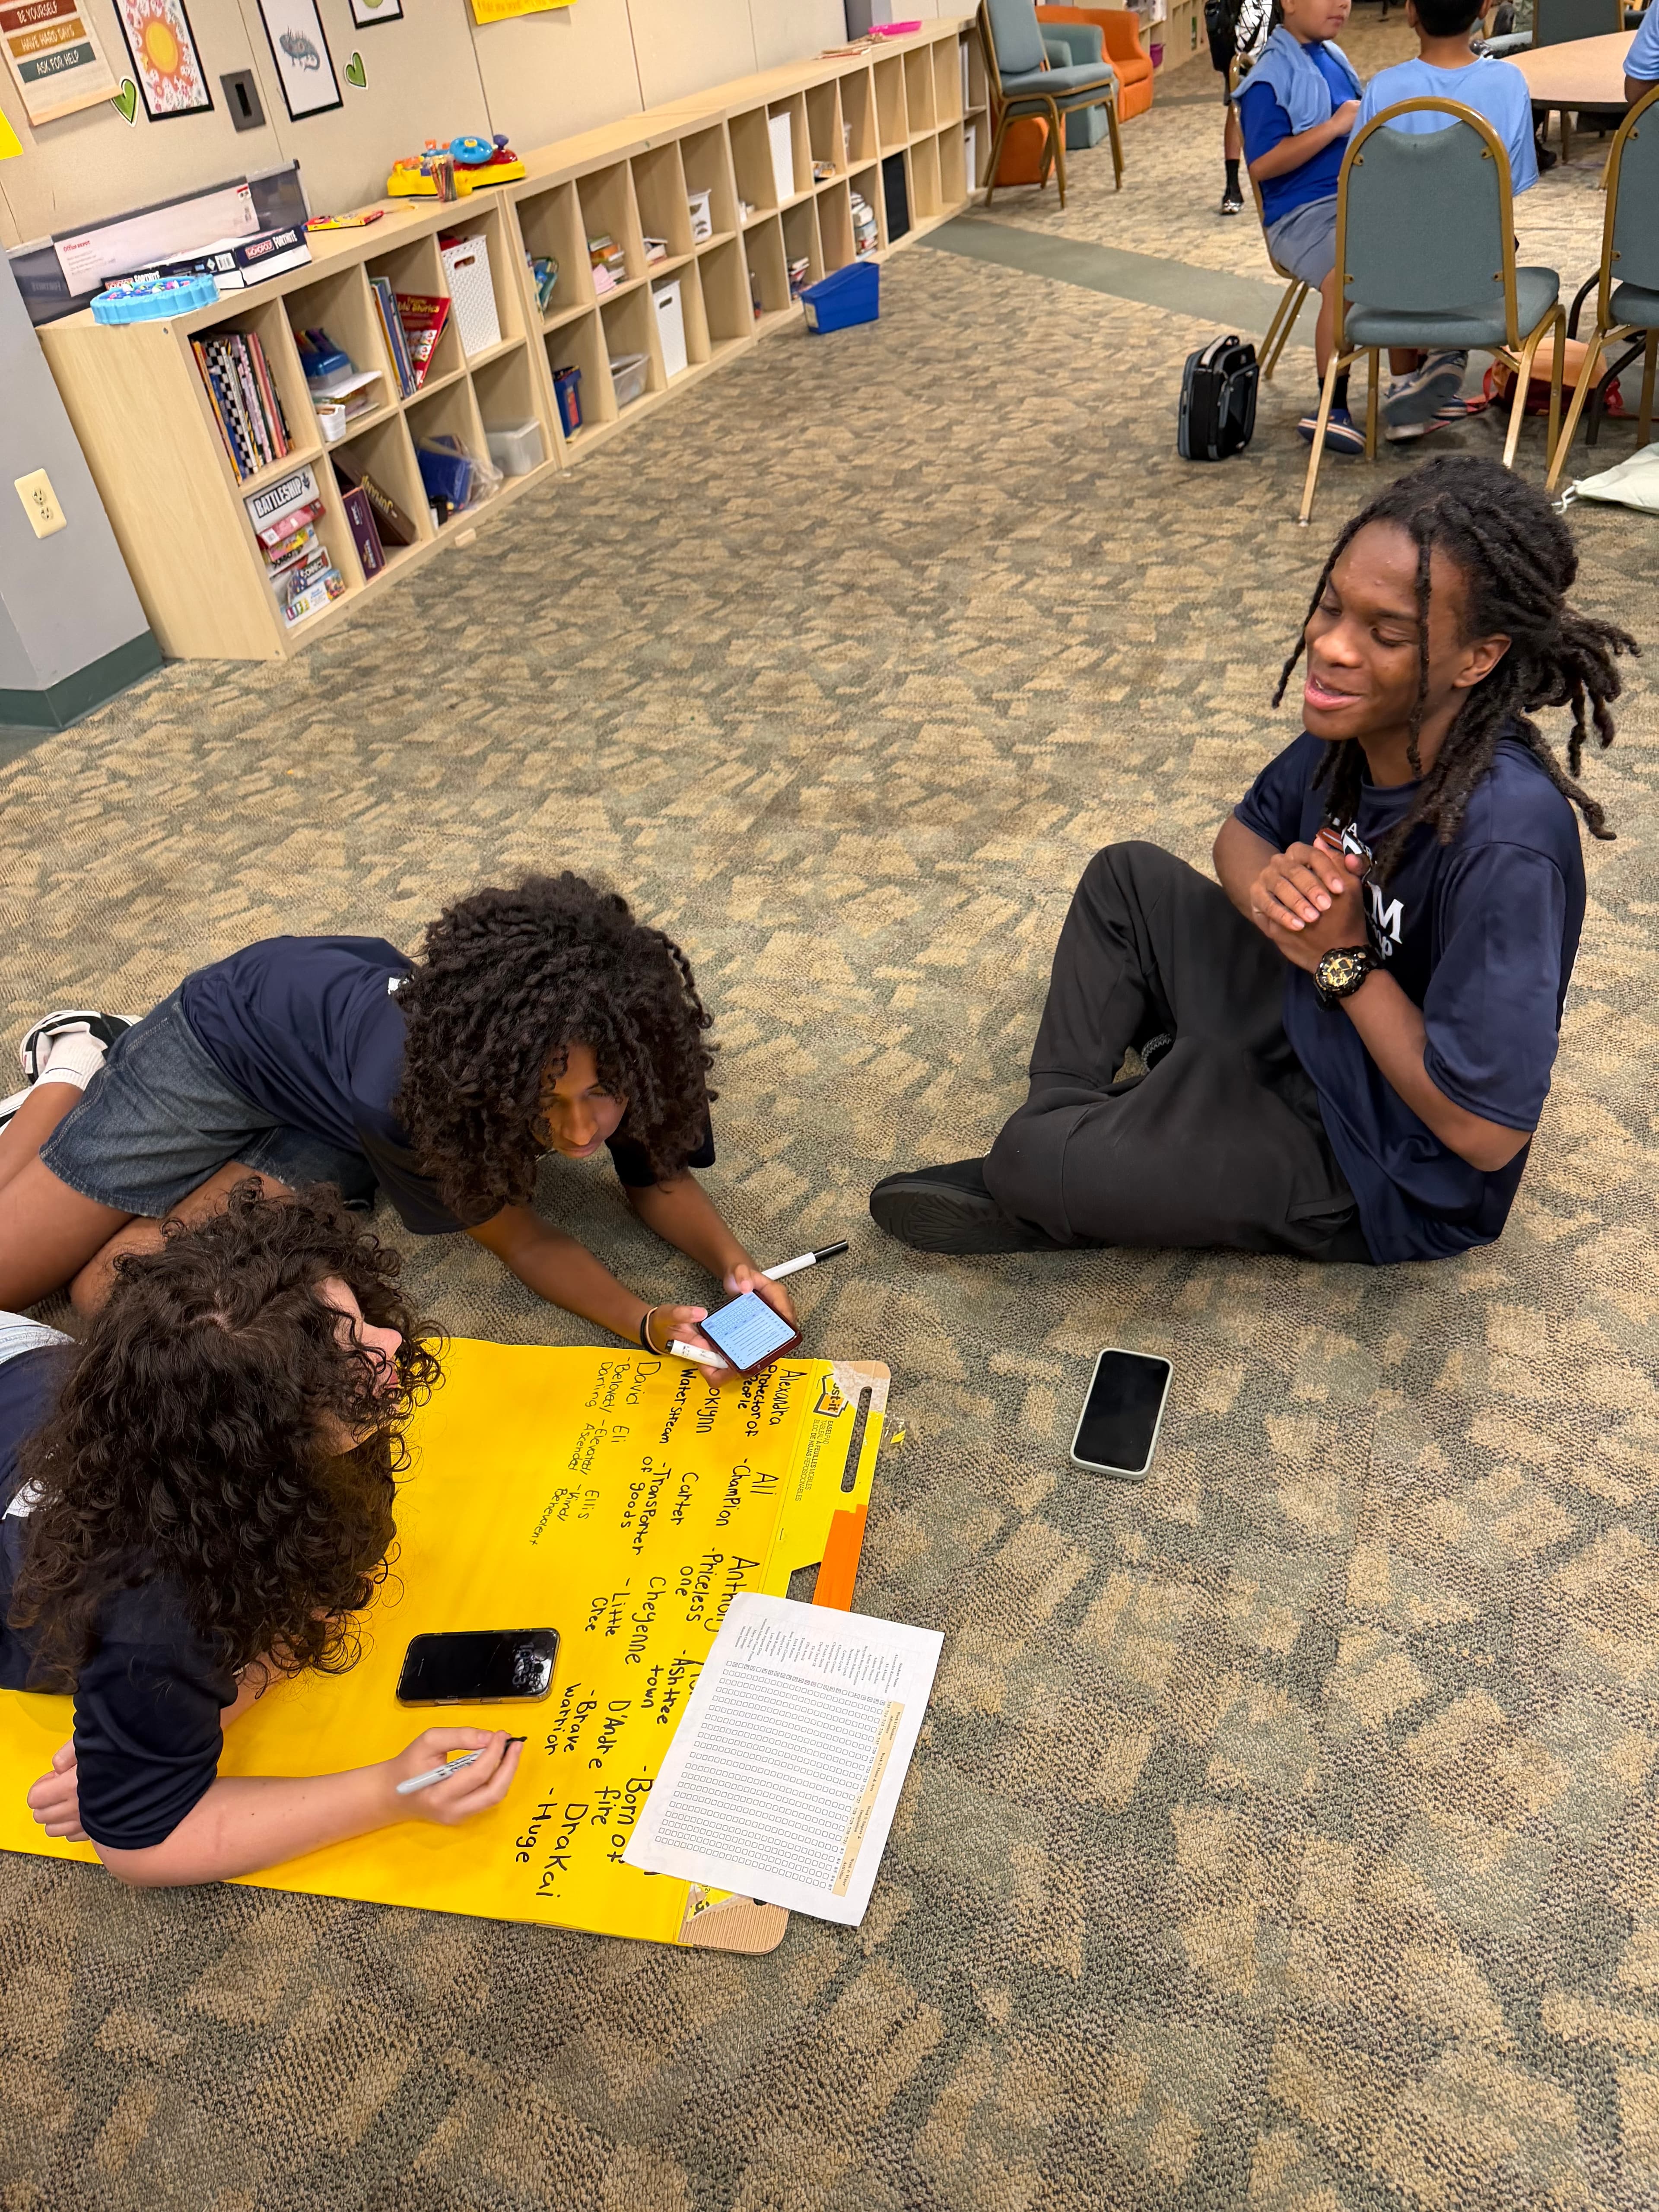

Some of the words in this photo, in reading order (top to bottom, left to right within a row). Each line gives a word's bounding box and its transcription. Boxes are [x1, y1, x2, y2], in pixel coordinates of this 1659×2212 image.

[17, 11, 26, 23] BE
[27, 0, 57, 20] YOURSELF
[21, 36, 39, 51] HAVE
[39, 30, 57, 45] HARD
[59, 25, 74, 40] DAYS
[36, 62, 50, 75] ASK
[50, 55, 64, 70] FOR
[65, 50, 79, 65] HELP
[272, 230, 297, 249] FORTNITE
[255, 478, 302, 517] BATTLESHIP
[585, 1362, 612, 1407] Darling
[626, 1362, 660, 1405] David
[769, 1369, 807, 1425] Alexandra
[826, 1382, 841, 1412] ost-it
[696, 1388, 720, 1433] oklynn
[611, 1425, 629, 1443] Eli
[745, 1421, 758, 1437] of
[817, 1420, 826, 1440] TABLEAU
[568, 1424, 594, 1470] Ascended
[805, 1440, 814, 1456] HOJAS
[810, 1446, 820, 1468] FEUILLES
[641, 1456, 652, 1473] of
[795, 1458, 810, 1501] REPOSICIONABLES
[805, 1469, 815, 1490] MOBILES
[577, 1490, 599, 1519] Ellis
[620, 1483, 644, 1528] goods
[671, 1473, 698, 1525] Carter
[675, 1566, 693, 1596] one
[625, 1576, 666, 1665] Cheyenne
[641, 1665, 664, 1708] town
[885, 1715, 893, 1733] Adventure
[591, 1786, 620, 1825] fire
[853, 1809, 864, 1832] Imagination
[838, 1861, 847, 1879] Activities
